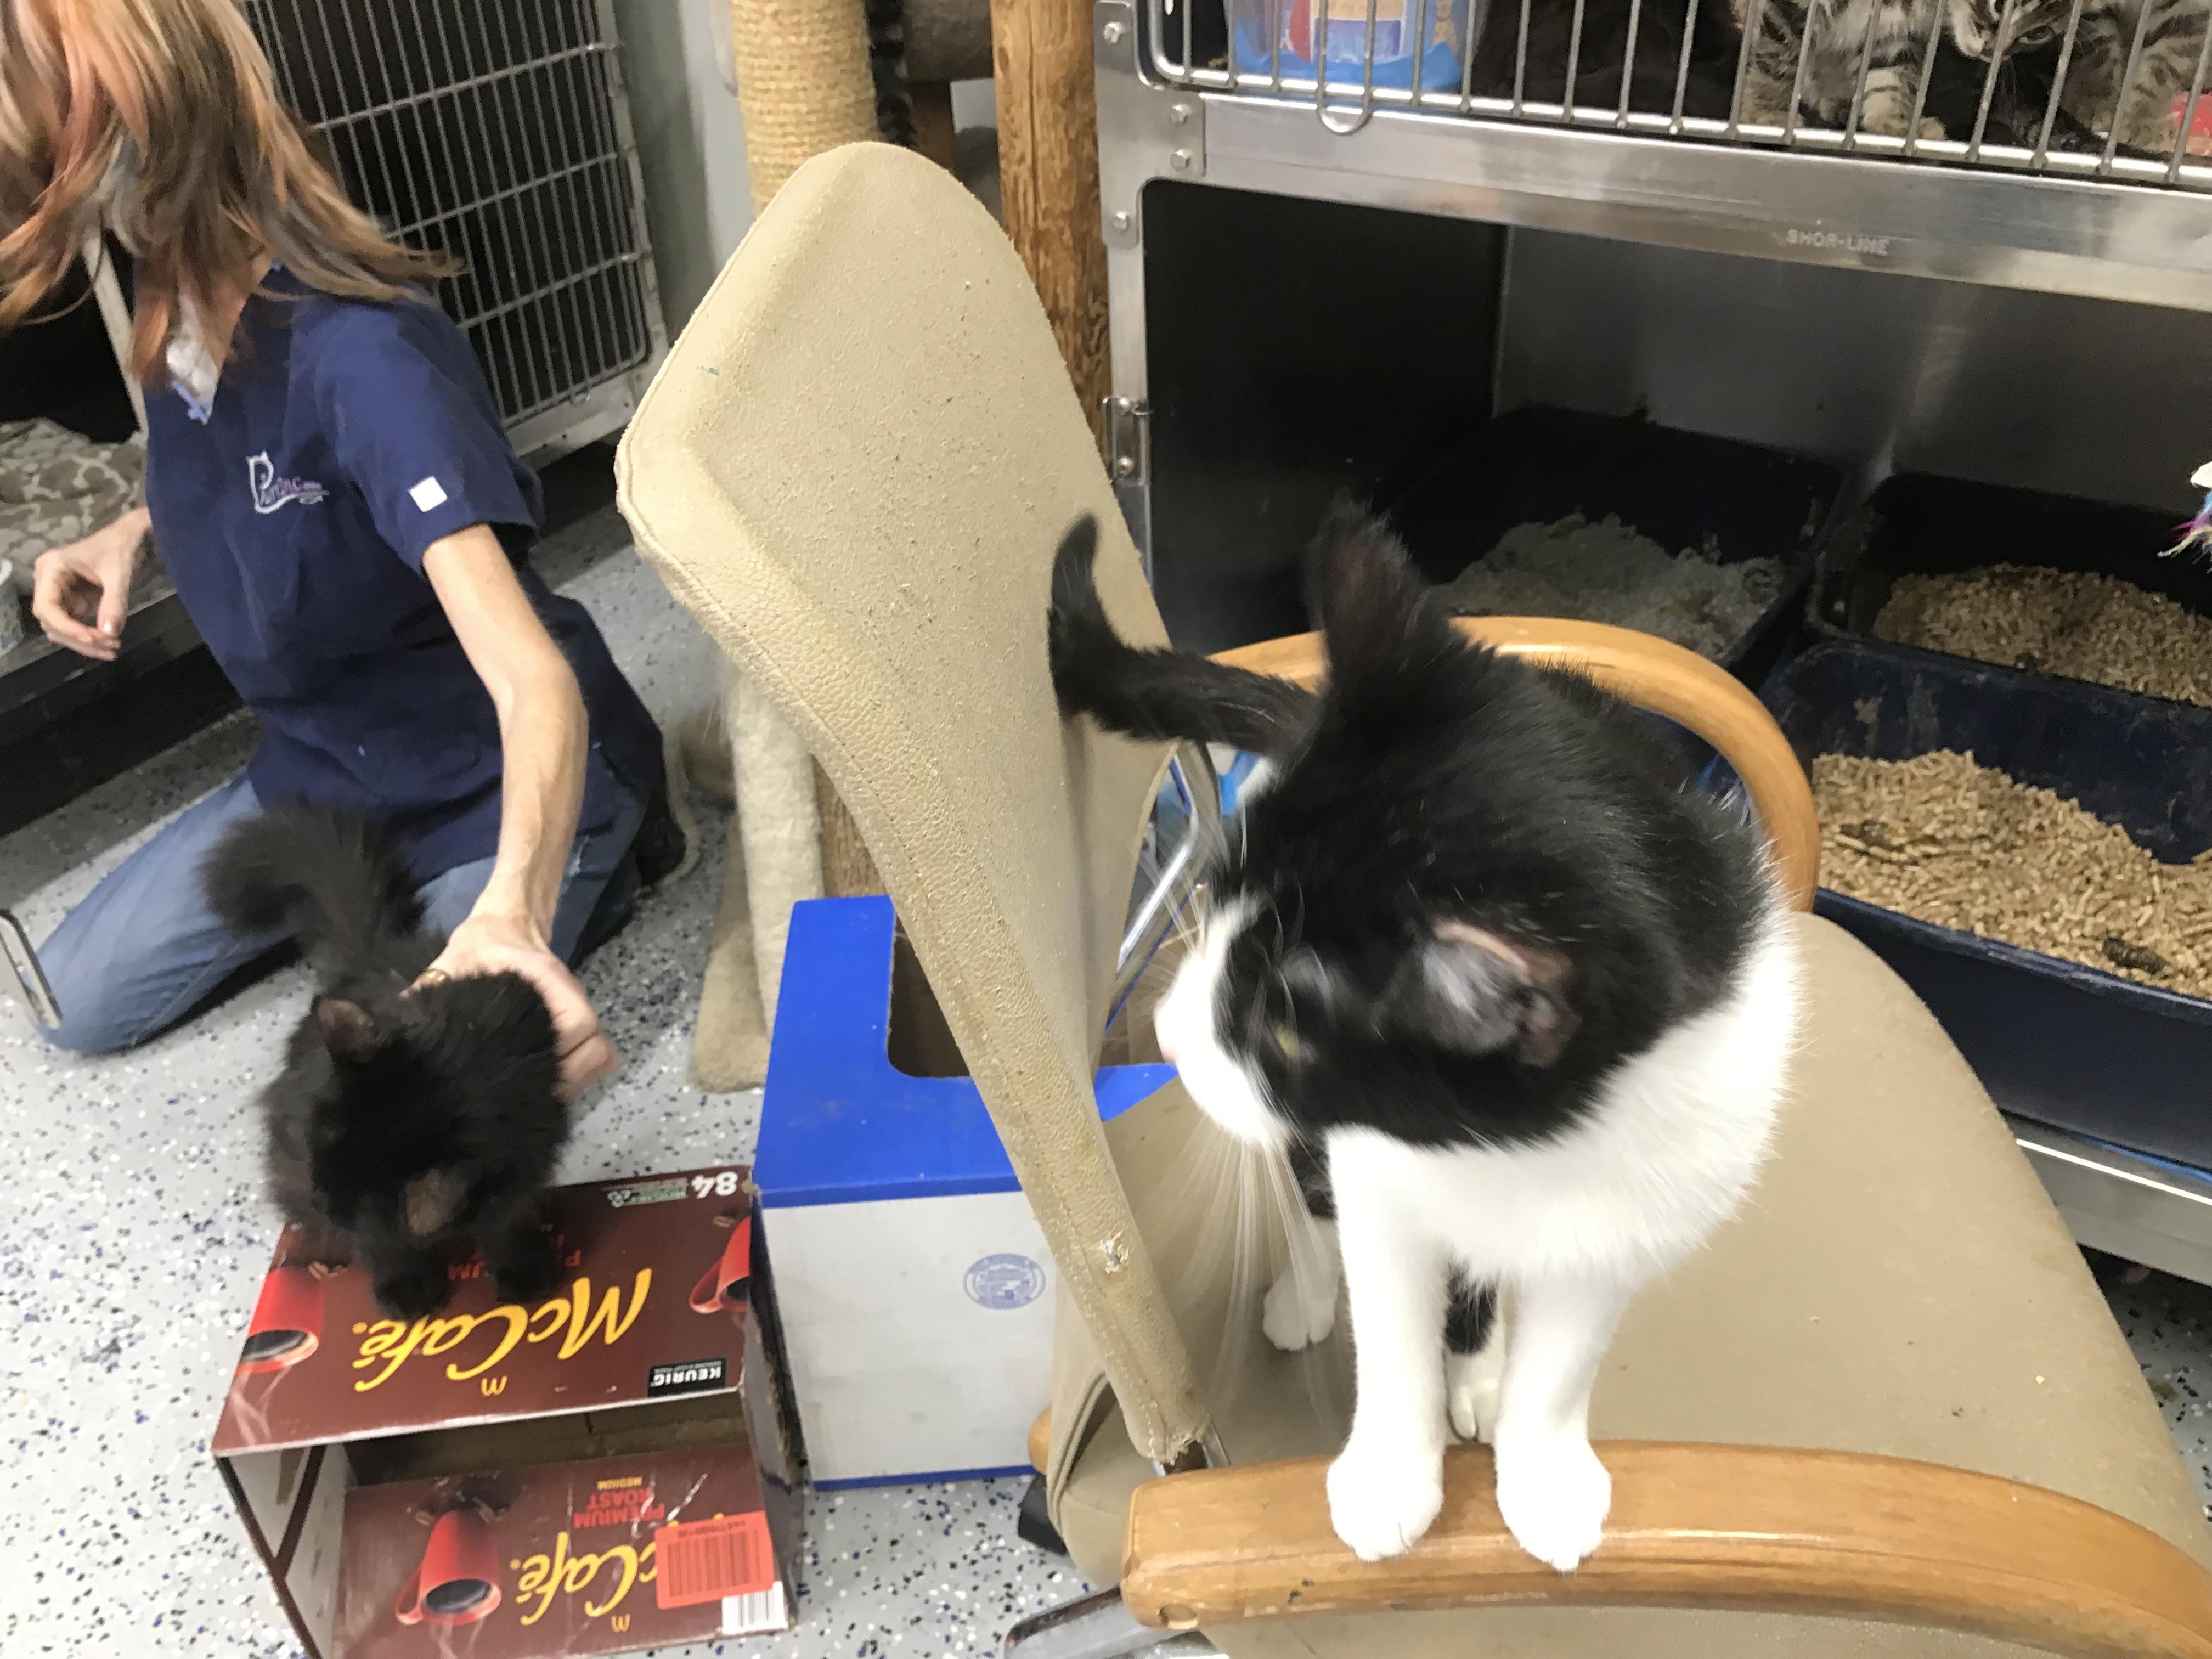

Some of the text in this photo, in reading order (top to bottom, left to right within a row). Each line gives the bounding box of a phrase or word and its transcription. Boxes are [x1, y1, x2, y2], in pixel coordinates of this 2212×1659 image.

[691, 1171, 738, 1199] 84
[352, 1267, 653, 1392] McCafé
[650, 1366, 722, 1387] KEURIG
[596, 1476, 643, 1491] MEDIUM
[587, 1487, 652, 1510] ROAST
[574, 1503, 665, 1529] PREMIUM
[515, 1531, 659, 1626] cCafé
